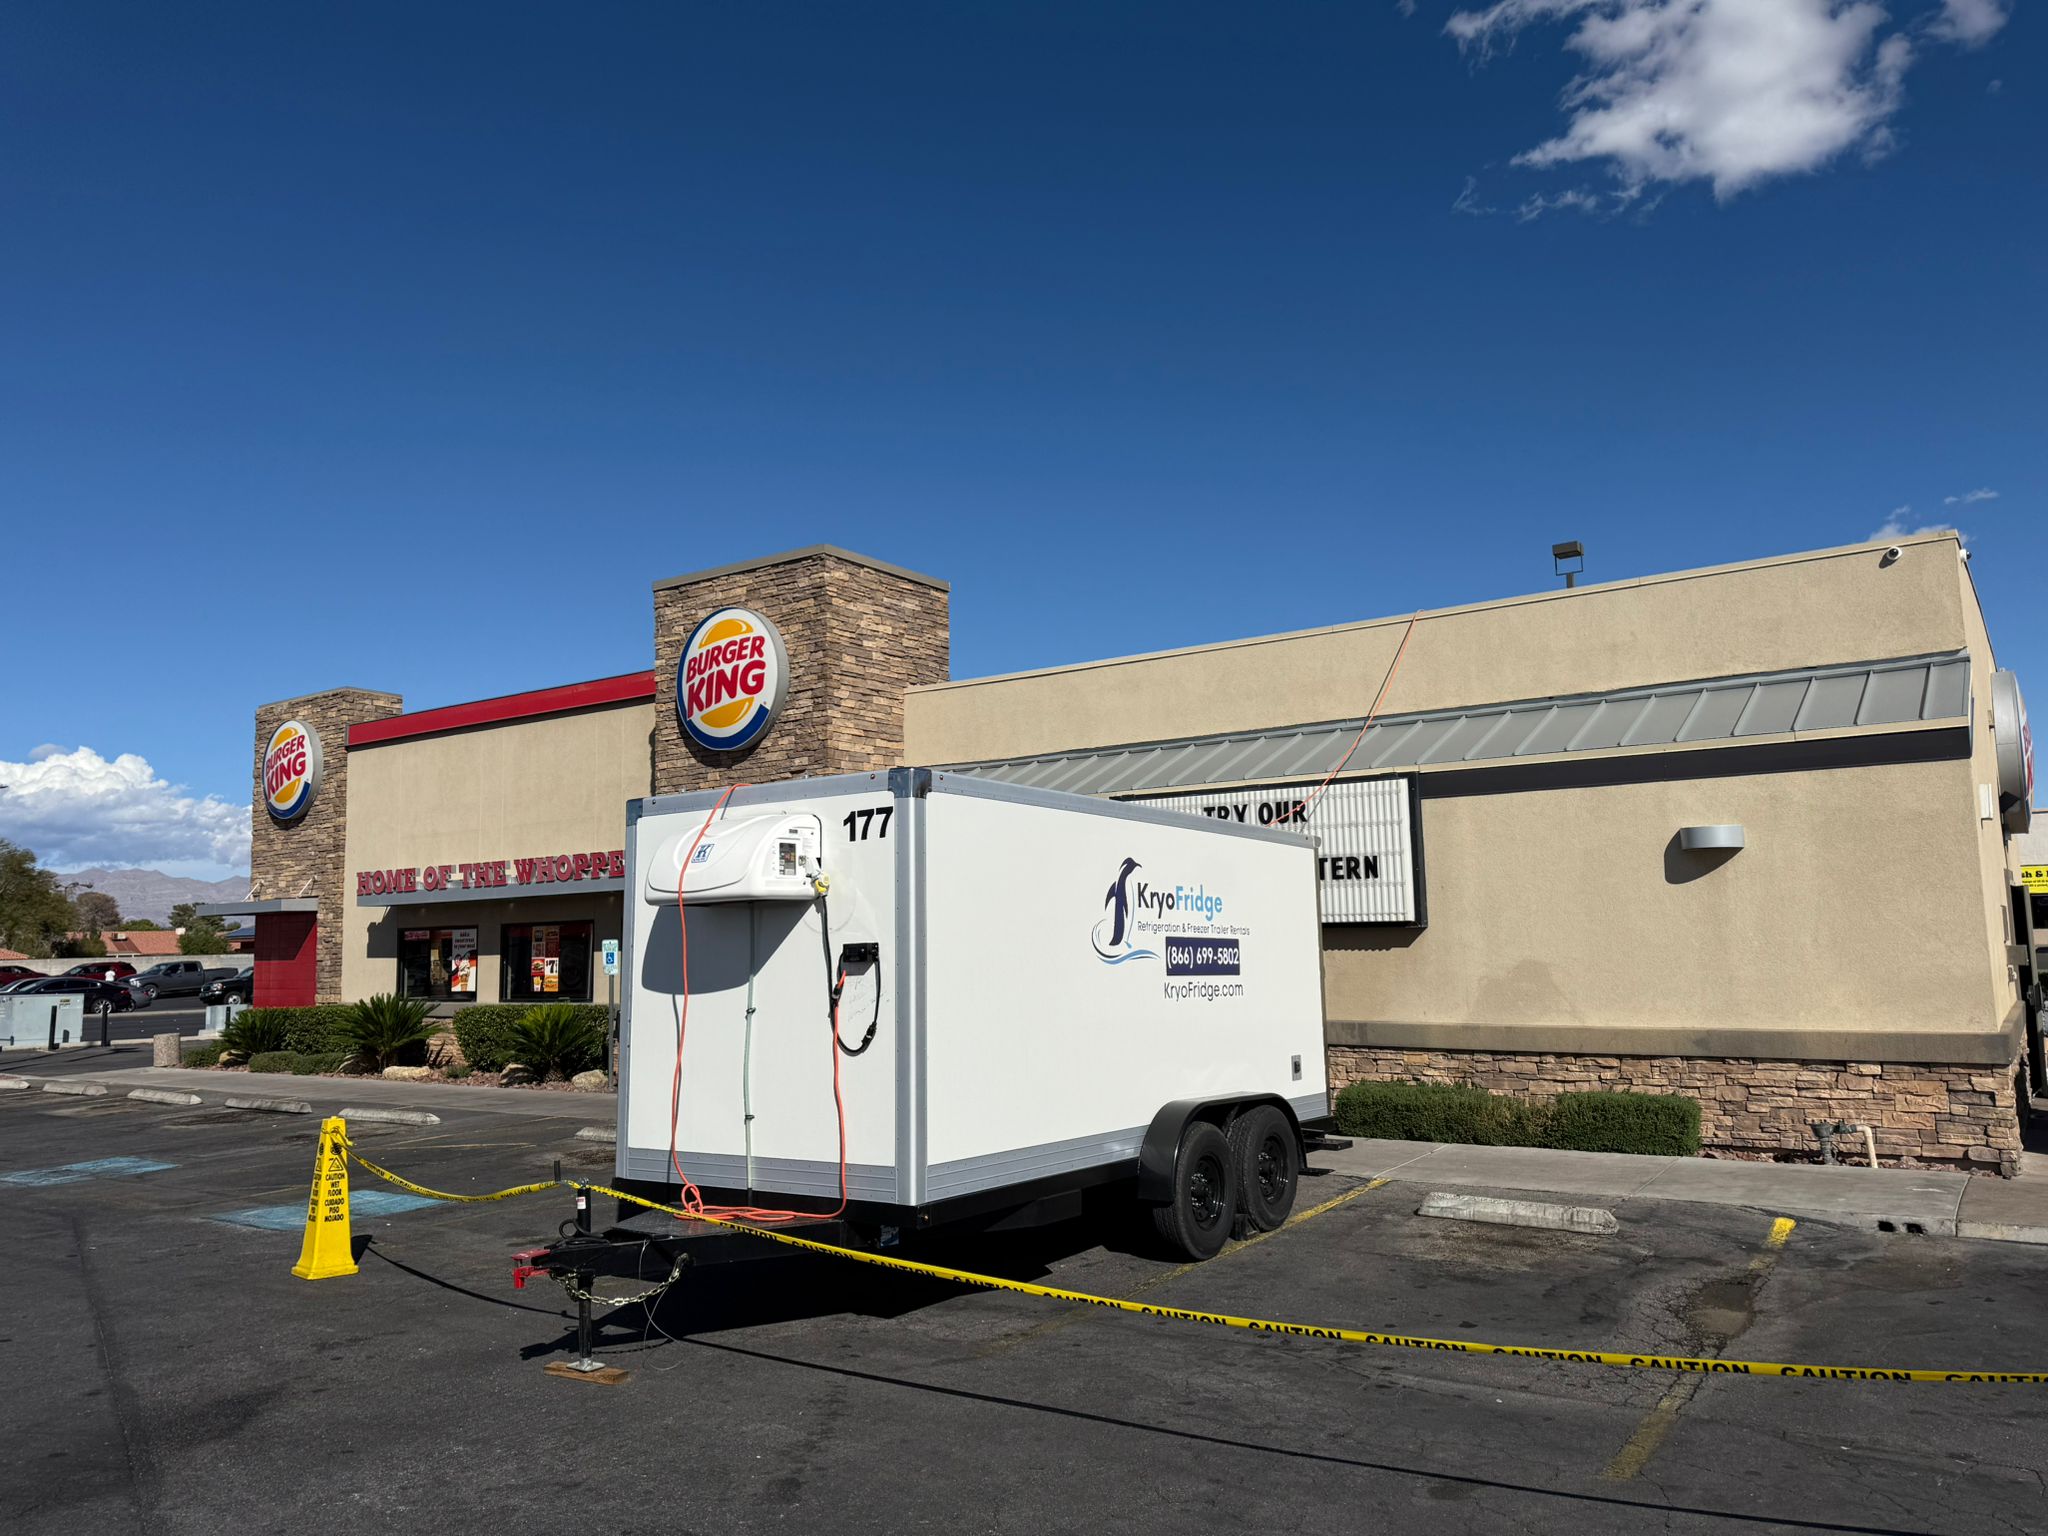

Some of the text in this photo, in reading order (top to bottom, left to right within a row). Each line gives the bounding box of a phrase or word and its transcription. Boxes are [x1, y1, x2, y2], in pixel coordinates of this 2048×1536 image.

[686, 635, 765, 684] BURGER
[687, 660, 766, 719] KING
[266, 735, 306, 776] BURGER
[266, 752, 306, 801] KING
[843, 806, 894, 842] 177
[1258, 800, 1308, 825] OUR
[356, 868, 417, 896] HOME
[423, 865, 452, 892] OF
[459, 861, 506, 889] THE
[1137, 882, 1223, 922] KryoFridge
[1137, 920, 1251, 936] Refrigeration & Freezer Trailer Rentals
[1167, 946, 1240, 969] (866) 699-5802
[1163, 981, 1244, 1002] KryoFridge.com
[326, 1173, 345, 1181] CAUTION
[328, 1189, 342, 1197] FLOOR
[329, 1206, 340, 1214] PISO
